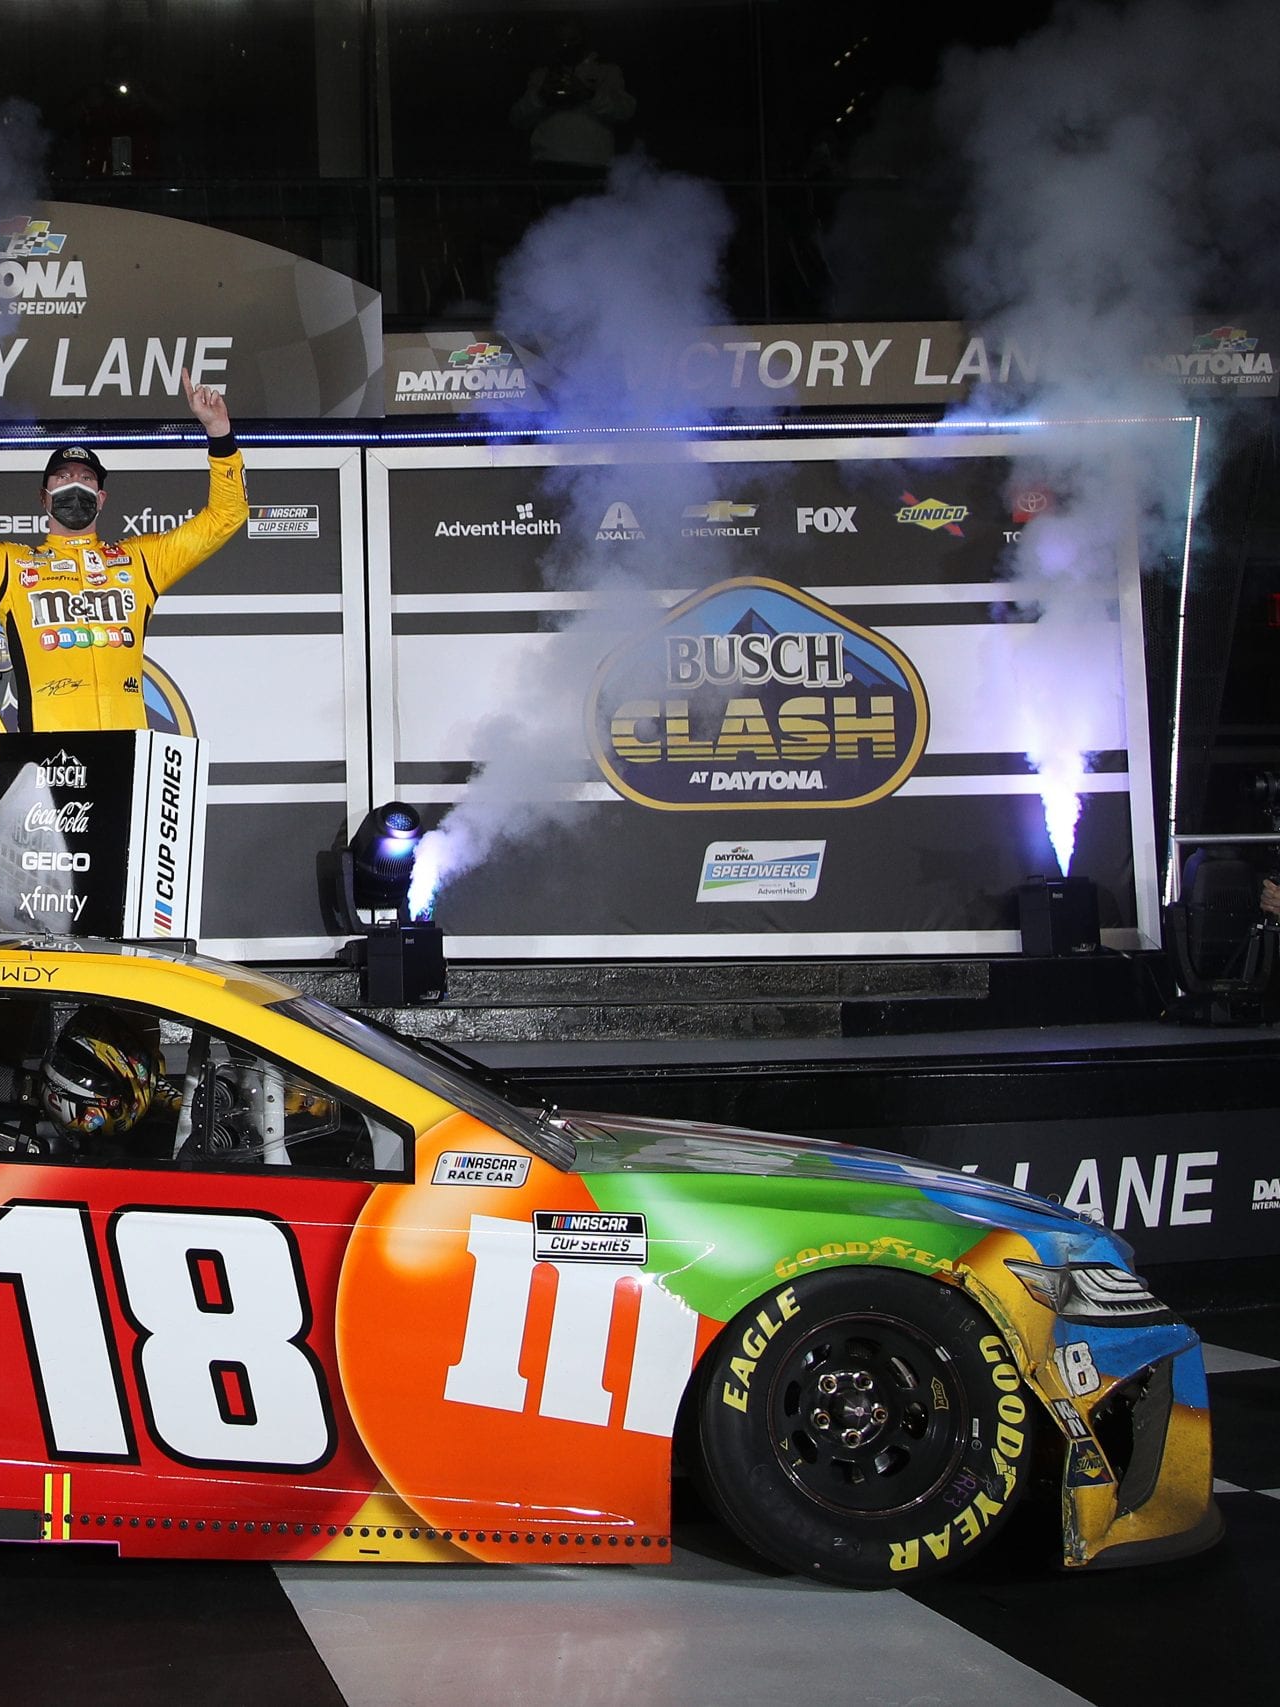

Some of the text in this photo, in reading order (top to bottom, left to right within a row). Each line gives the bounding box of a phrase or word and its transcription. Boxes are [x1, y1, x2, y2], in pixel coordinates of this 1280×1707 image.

[8, 301, 87, 315] SPEEDWAY
[50, 336, 233, 397] LANE
[914, 337, 1042, 384] LAN
[1147, 352, 1274, 376] AYTONA
[397, 368, 527, 392] DAYTONA
[1220, 375, 1273, 385] SPEEDWAY
[395, 390, 526, 402] INTERNATIONAL SPEEDWAY
[122, 508, 194, 536] xfinit
[269, 508, 309, 518] NASCAR
[797, 506, 858, 533] FOX
[898, 506, 966, 522] SUNOCO
[258, 522, 309, 531] CUP SERIES
[434, 519, 561, 538] AdventHealth
[595, 529, 646, 541] AXALTA
[681, 527, 760, 538] CHEVROLET
[667, 633, 843, 688] BUSCH
[610, 696, 896, 763] CLASH
[35, 765, 87, 788] BUSCH
[689, 771, 824, 791] AT DAYTONA
[156, 745, 182, 901] CUP SERIES
[22, 851, 90, 872] GEICO
[714, 853, 754, 861] DAYTONA
[711, 864, 810, 878] SPEEDWEEKS
[20, 886, 88, 921] xfinity
[466, 1157, 517, 1171] NASCAR
[448, 1170, 513, 1182] RACE CAR
[570, 1215, 628, 1231] NASCAR
[550, 1236, 631, 1253] CUP SERIES
[722, 1286, 802, 1413] EAGLE
[889, 1335, 1026, 1571] GOODYEAR
